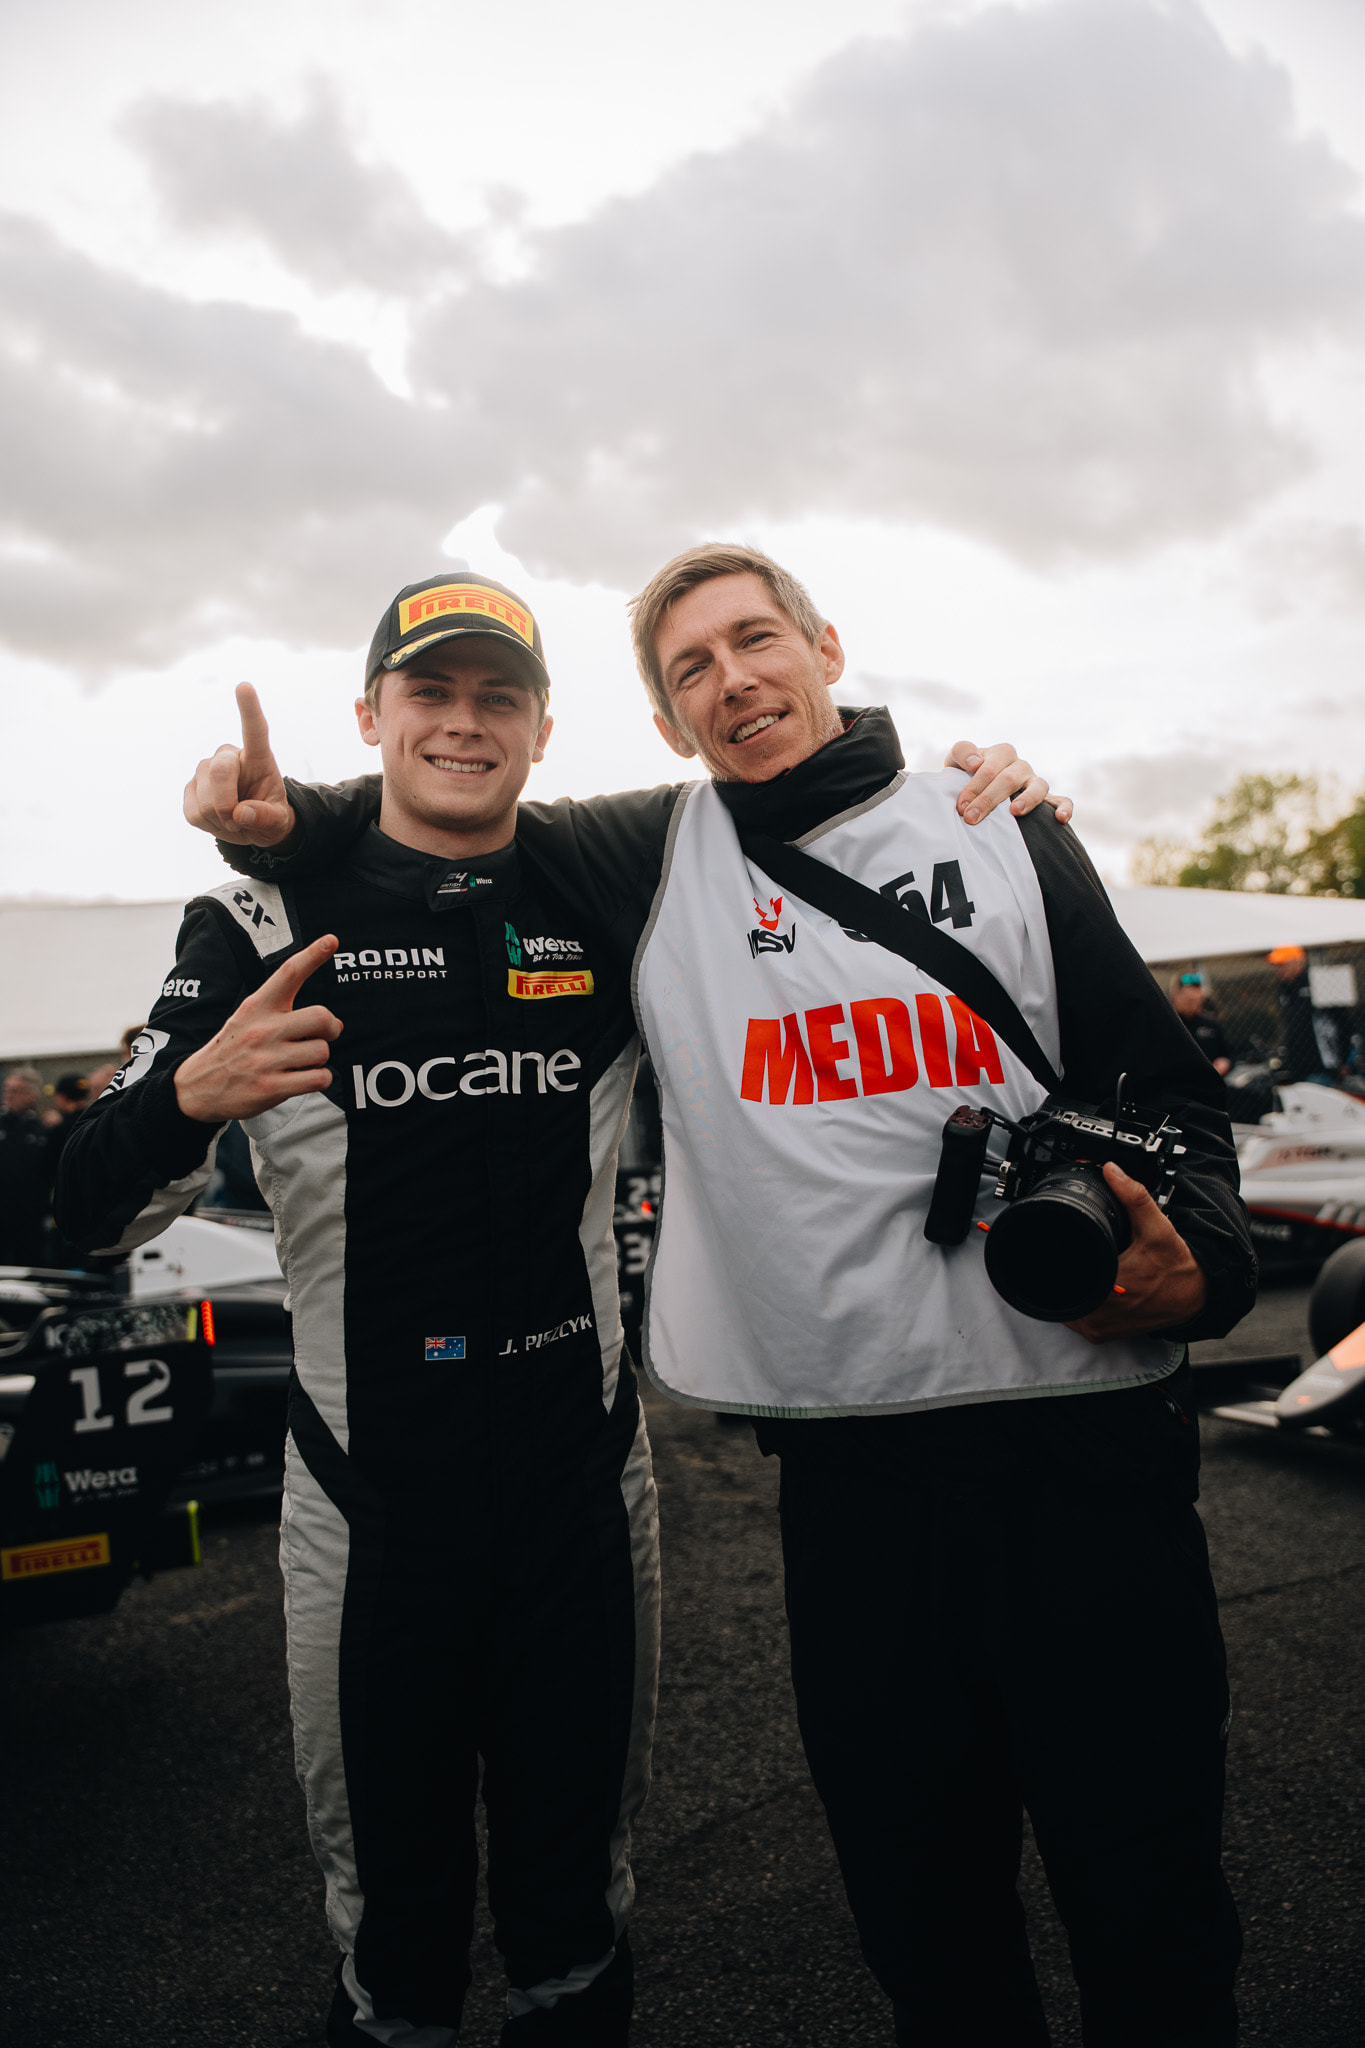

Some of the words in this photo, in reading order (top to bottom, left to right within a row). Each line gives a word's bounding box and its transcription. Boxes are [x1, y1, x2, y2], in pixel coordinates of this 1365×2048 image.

[408, 589, 526, 635] PIRELLI
[333, 946, 446, 971] RODIN
[522, 936, 585, 956] Wera
[163, 978, 201, 998] era
[337, 970, 448, 984] MOTORSPORT
[516, 974, 587, 996] PIRELLI
[740, 993, 1005, 1105] MEDIA
[498, 1337, 518, 1356] J.
[69, 1358, 174, 1433] 12
[63, 1466, 139, 1493] Wera
[9, 1540, 103, 1574] PIRELLI
